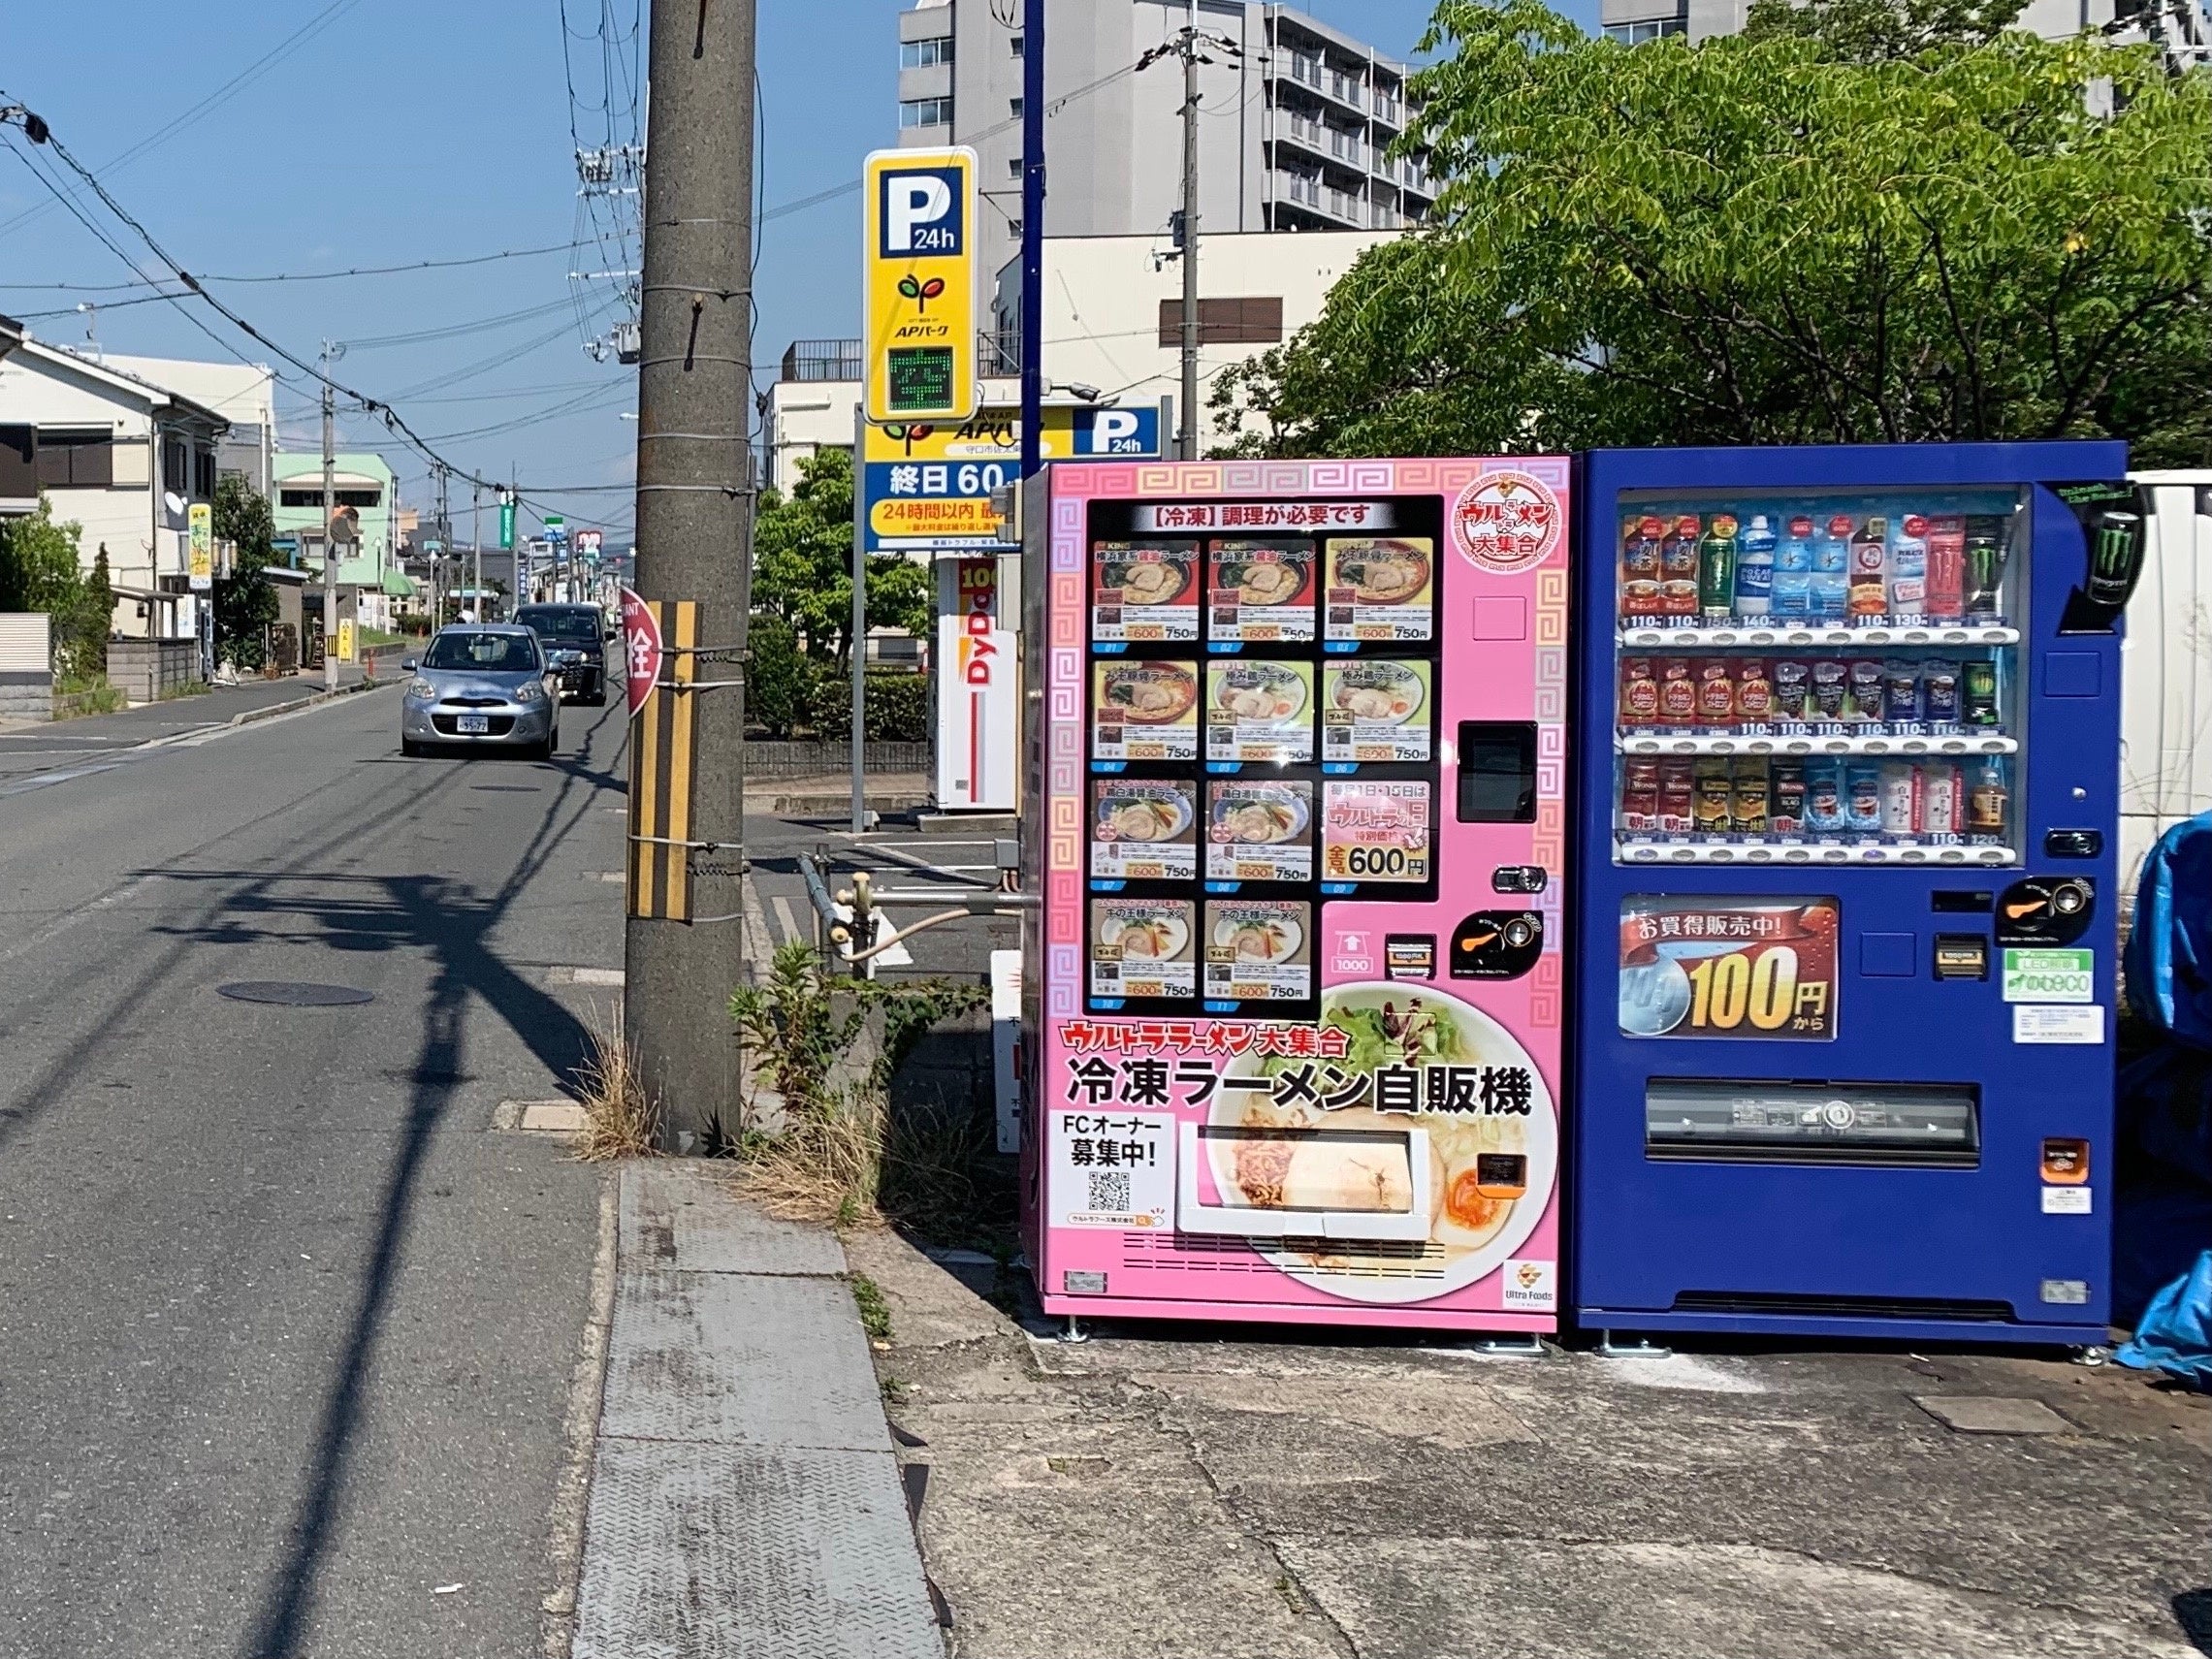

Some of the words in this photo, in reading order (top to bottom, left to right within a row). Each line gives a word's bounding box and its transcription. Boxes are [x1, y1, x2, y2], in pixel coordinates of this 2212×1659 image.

[887, 175, 951, 251] P
[914, 228, 955, 250] 24h
[894, 325, 949, 338] APパーク
[1092, 411, 1138, 453] P
[1112, 438, 1141, 453] 24h
[889, 464, 947, 495] 終日
[882, 502, 975, 521] 24時間以内
[1473, 533, 1540, 556] 大集合
[1166, 628, 1198, 639] 750円
[1395, 628, 1428, 638] 750円
[1395, 749, 1428, 759] 750円
[1275, 868, 1308, 879] 750円
[1639, 914, 1781, 940] お買得販売中!
[1336, 959, 1368, 970] 1000
[1270, 987, 1303, 997] 750円
[1689, 946, 1828, 1030] 100円
[1794, 1017, 1825, 1031] から
[1067, 1058, 1534, 1117] 冷凍ラーメン自販機
[1063, 1115, 1162, 1135] FCオーナー
[1071, 1137, 1156, 1168] 募集中!
[1505, 1290, 1527, 1300] Ultra
[1528, 1291, 1553, 1301] Foods
